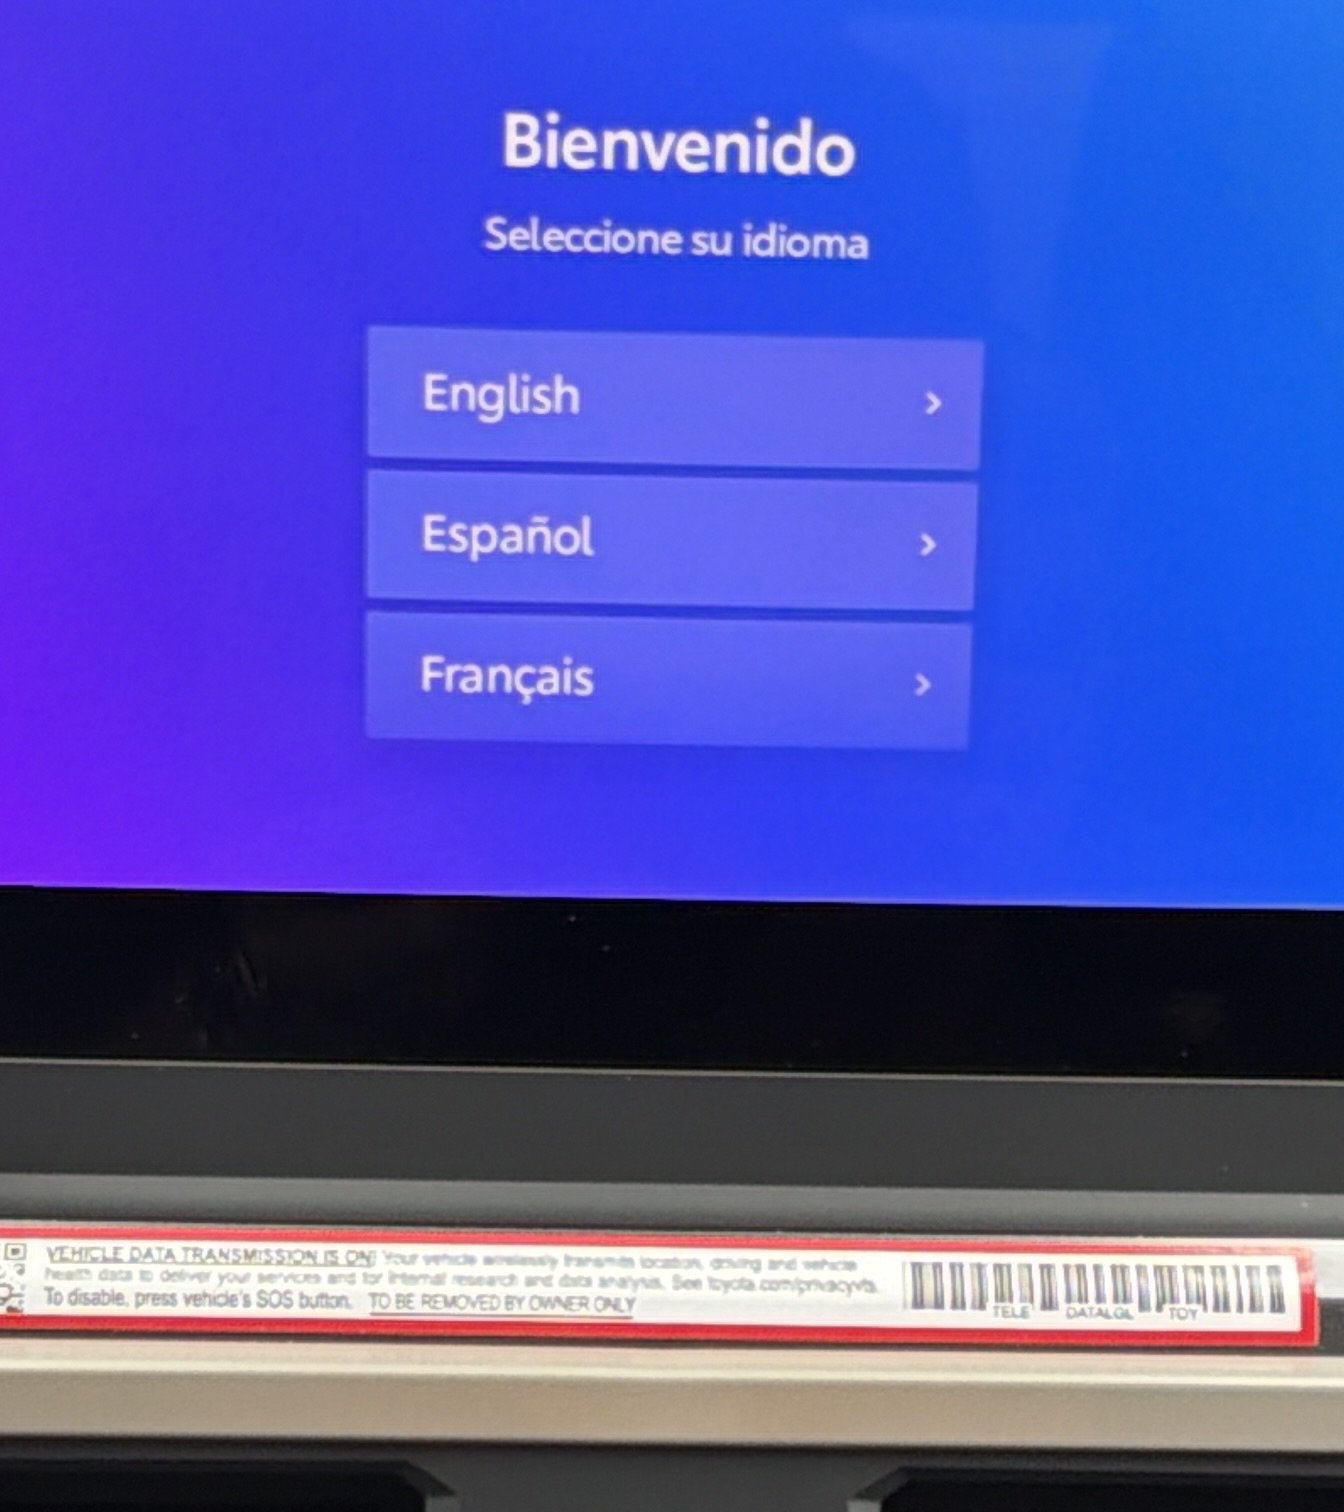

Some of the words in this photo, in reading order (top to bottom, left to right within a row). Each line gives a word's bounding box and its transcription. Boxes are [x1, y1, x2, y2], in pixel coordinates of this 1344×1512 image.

[503, 110, 857, 177] Bienvenido
[483, 215, 684, 256] Seleccione
[690, 229, 733, 257] su
[742, 221, 871, 262] idioma
[423, 371, 581, 424] English
[422, 513, 596, 562] Español
[421, 654, 595, 705] Français
[46, 1245, 124, 1263] VEHICLE
[129, 1246, 176, 1263] DATA
[181, 1247, 318, 1265] TRANSMISSION
[324, 1249, 339, 1265] IS
[43, 1286, 63, 1306] To
[135, 1291, 178, 1309] press
[183, 1289, 251, 1308] vehicle's
[256, 1289, 294, 1309] SOS
[368, 1292, 391, 1310] TO
[395, 1293, 415, 1310] BE
[421, 1293, 500, 1311] REMOVED
[504, 1295, 525, 1311] BY
[529, 1295, 590, 1312] OWNER
[594, 1296, 637, 1313] ONLY
